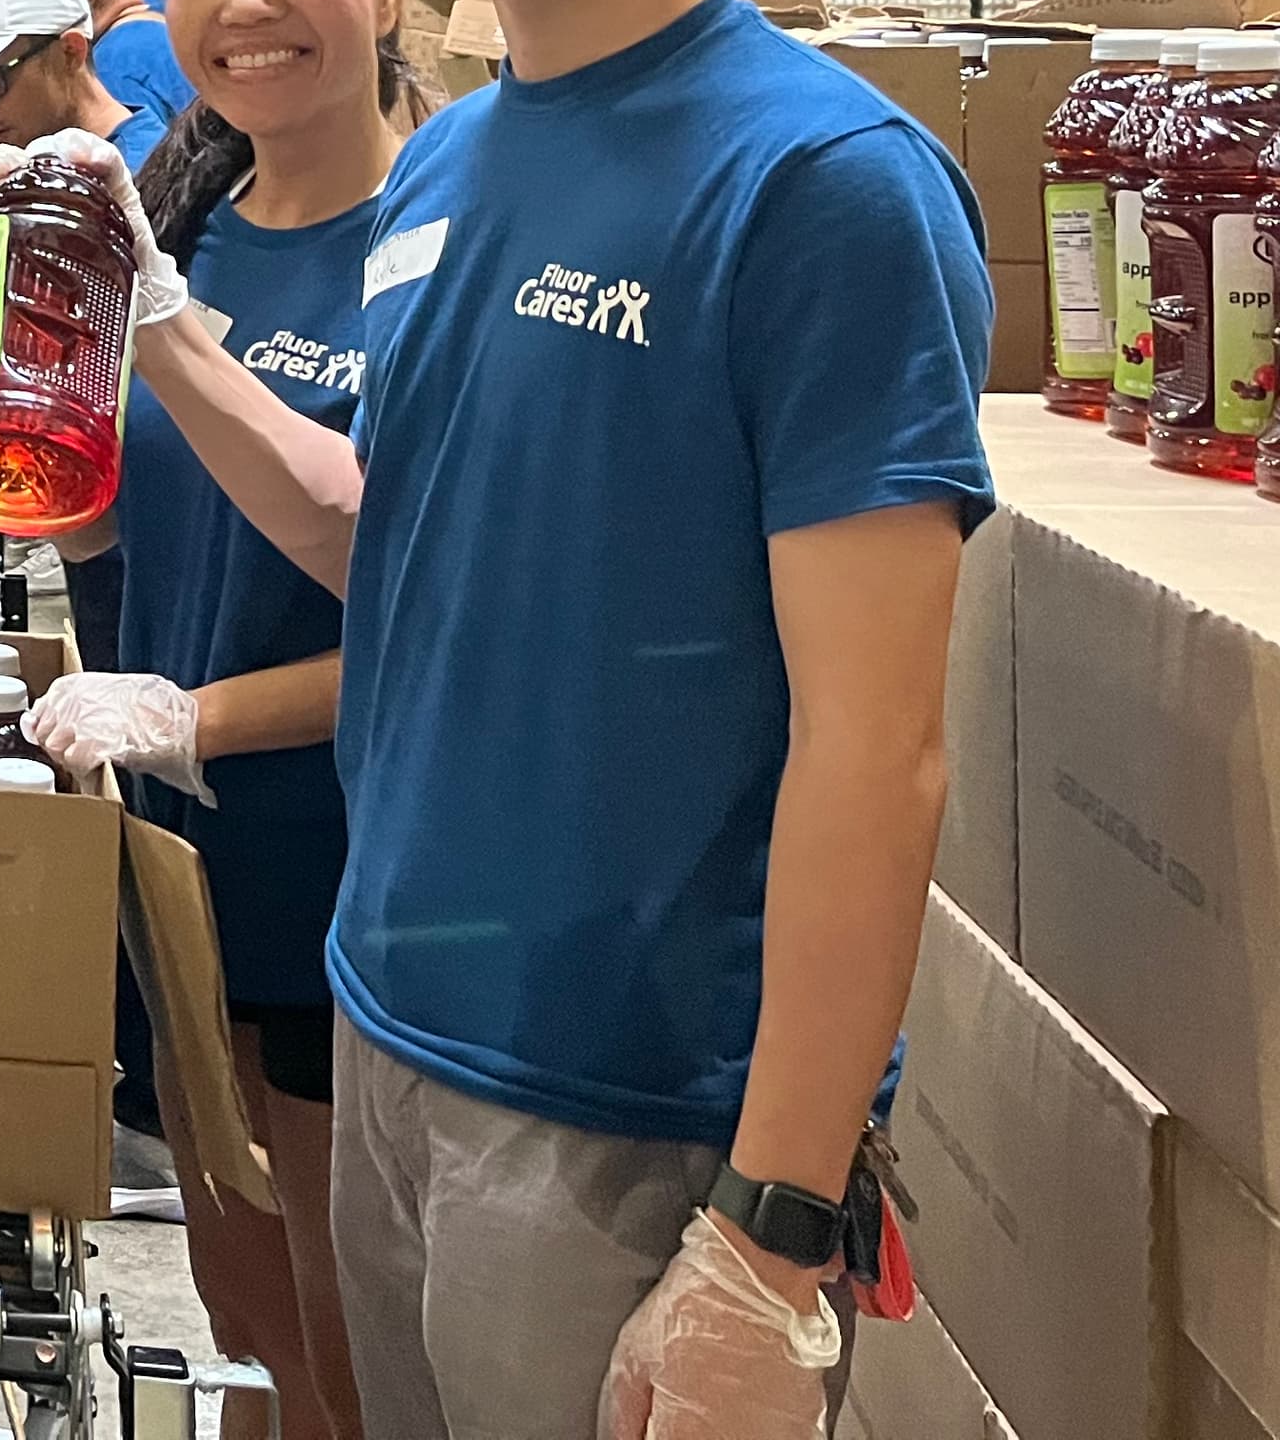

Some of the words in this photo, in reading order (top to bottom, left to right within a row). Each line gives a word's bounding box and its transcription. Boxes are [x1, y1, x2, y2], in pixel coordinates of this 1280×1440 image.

[539, 263, 598, 294] Fluor
[513, 278, 589, 327] Cares
[243, 341, 320, 381] Cares
[269, 330, 330, 360] Fluor
